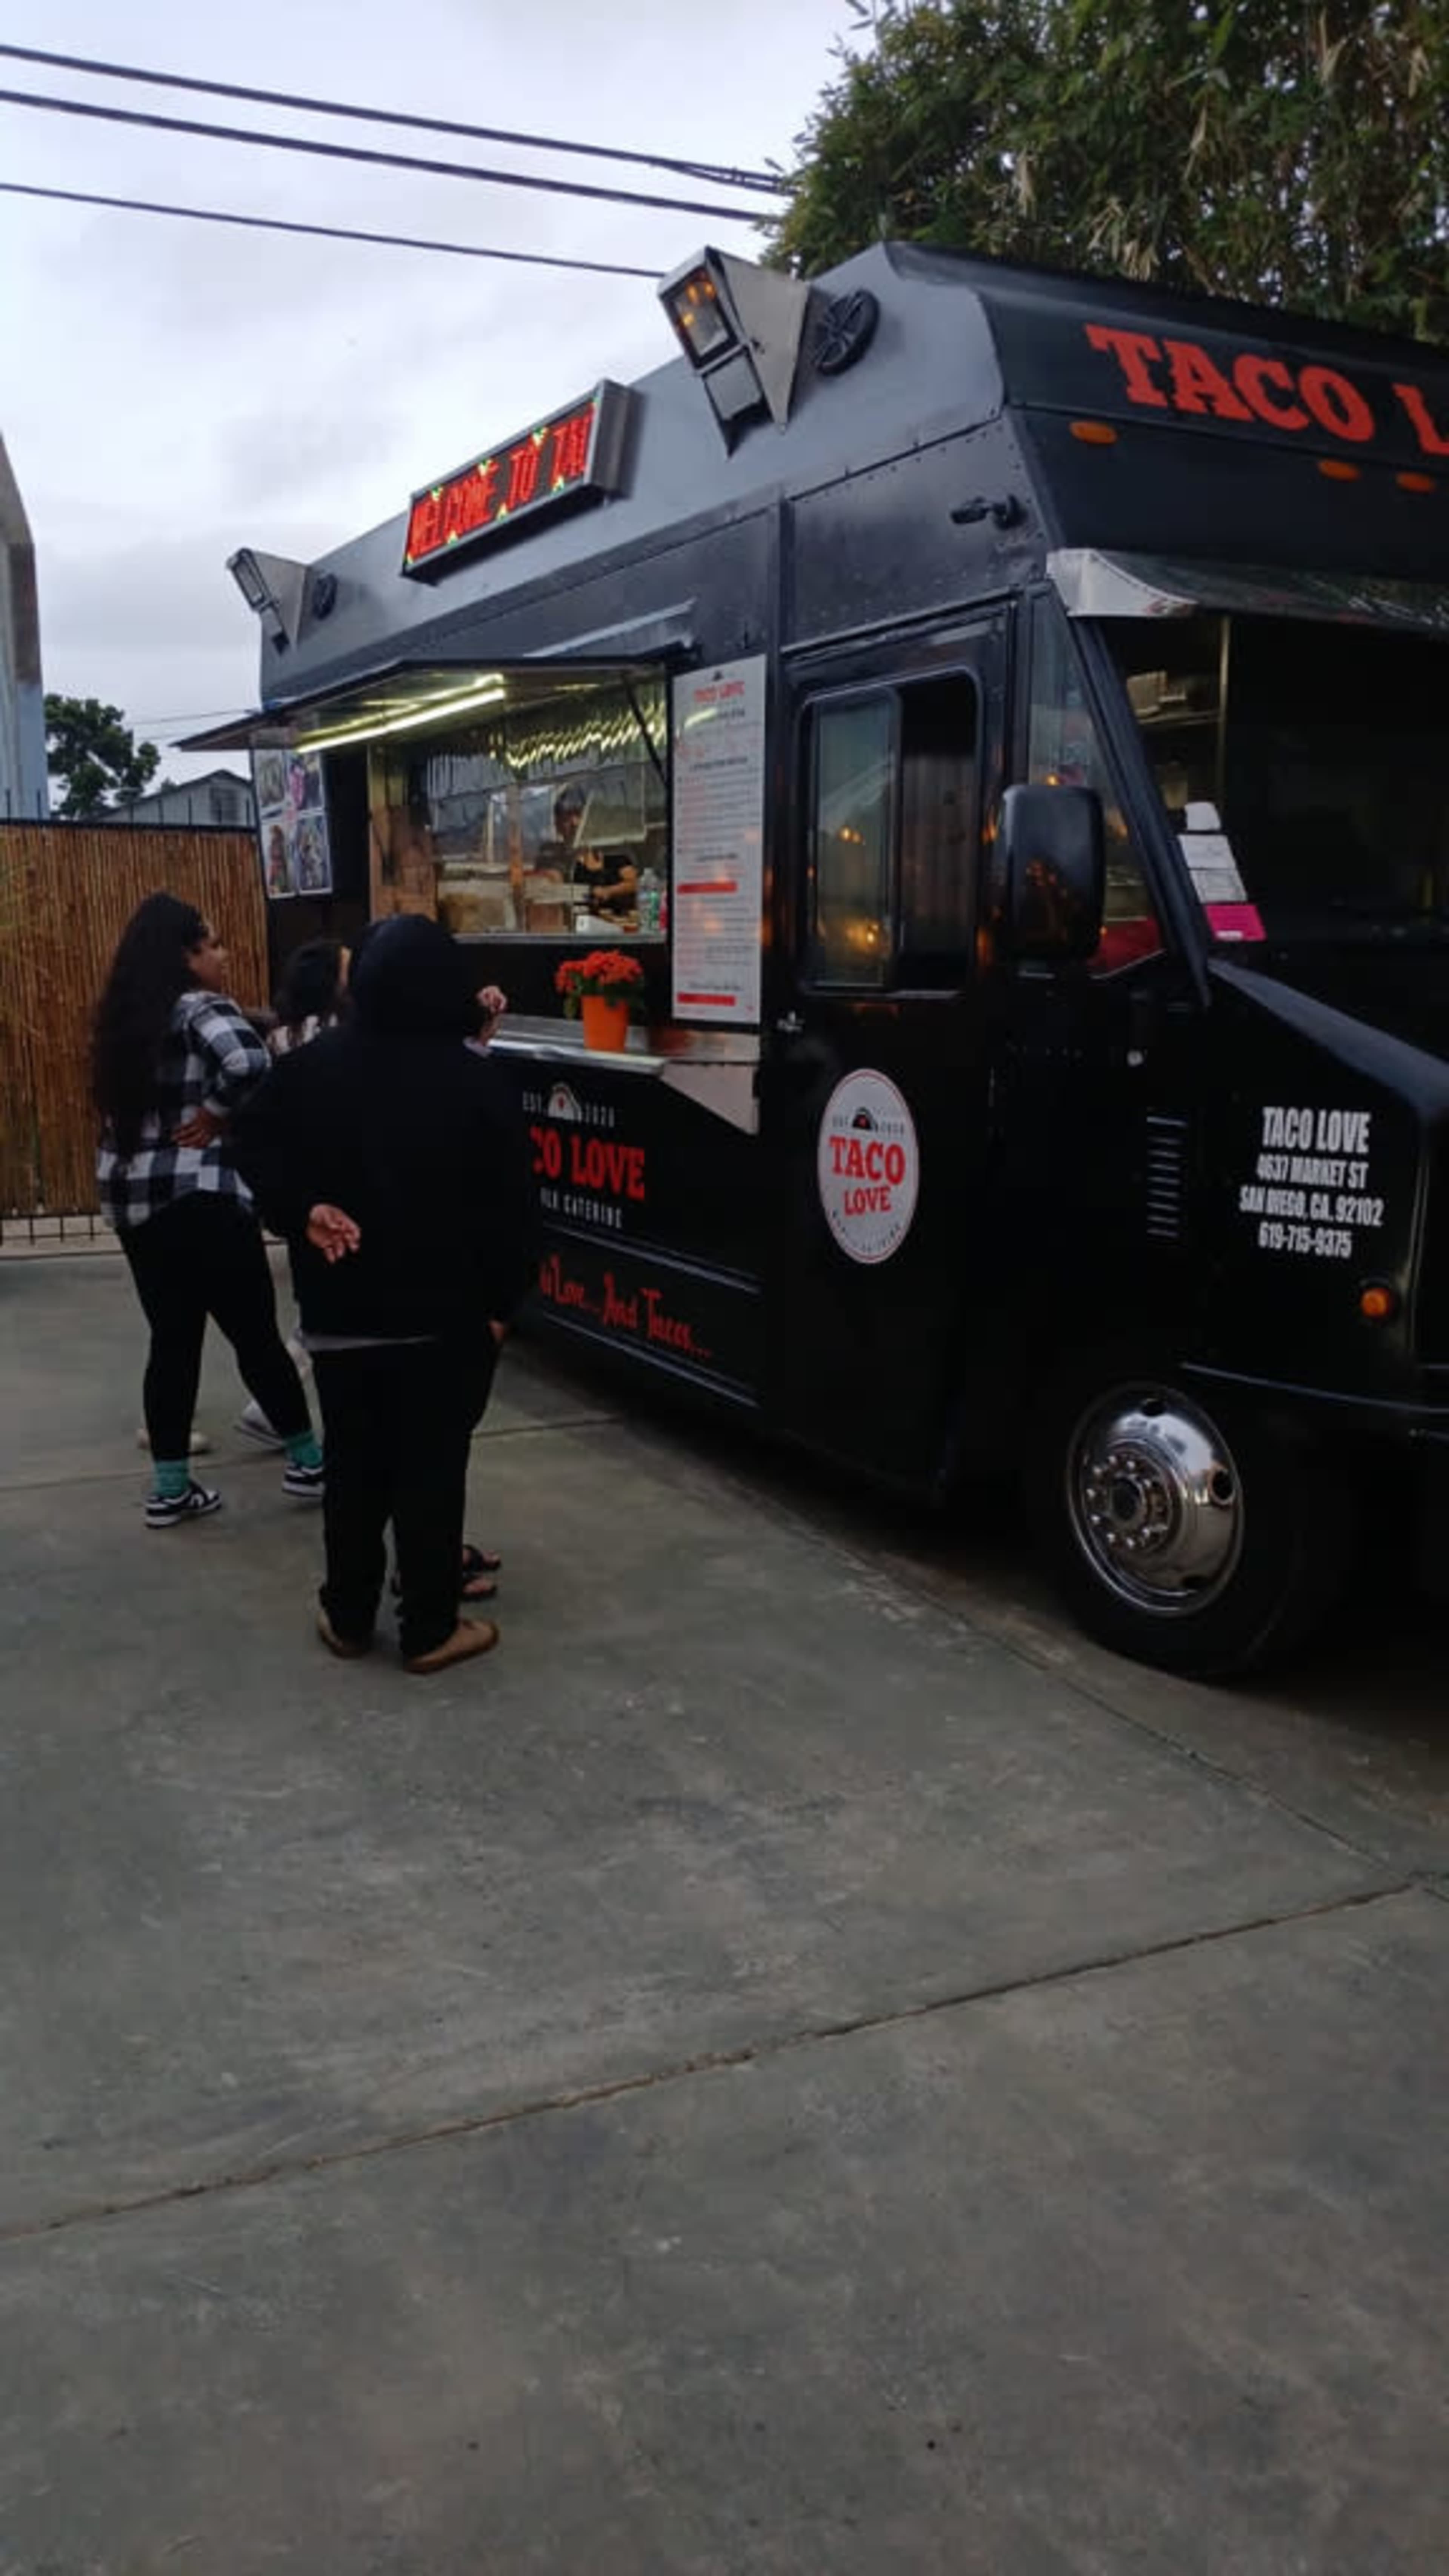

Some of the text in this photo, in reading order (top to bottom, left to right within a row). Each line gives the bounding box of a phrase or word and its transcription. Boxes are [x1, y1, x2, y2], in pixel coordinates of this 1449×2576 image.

[1084, 323, 1375, 442] TACO
[506, 434, 540, 513] TO
[1263, 1107, 1370, 1153] TACO LOVE
[571, 1135, 645, 1201] LOVE
[829, 1136, 906, 1185] TACO
[1290, 1156, 1347, 1187] MARKET
[1348, 1161, 1369, 1189] ST
[844, 1186, 892, 1216] LOVE
[1240, 1186, 1266, 1213] SAN
[1335, 1195, 1384, 1228] 92102
